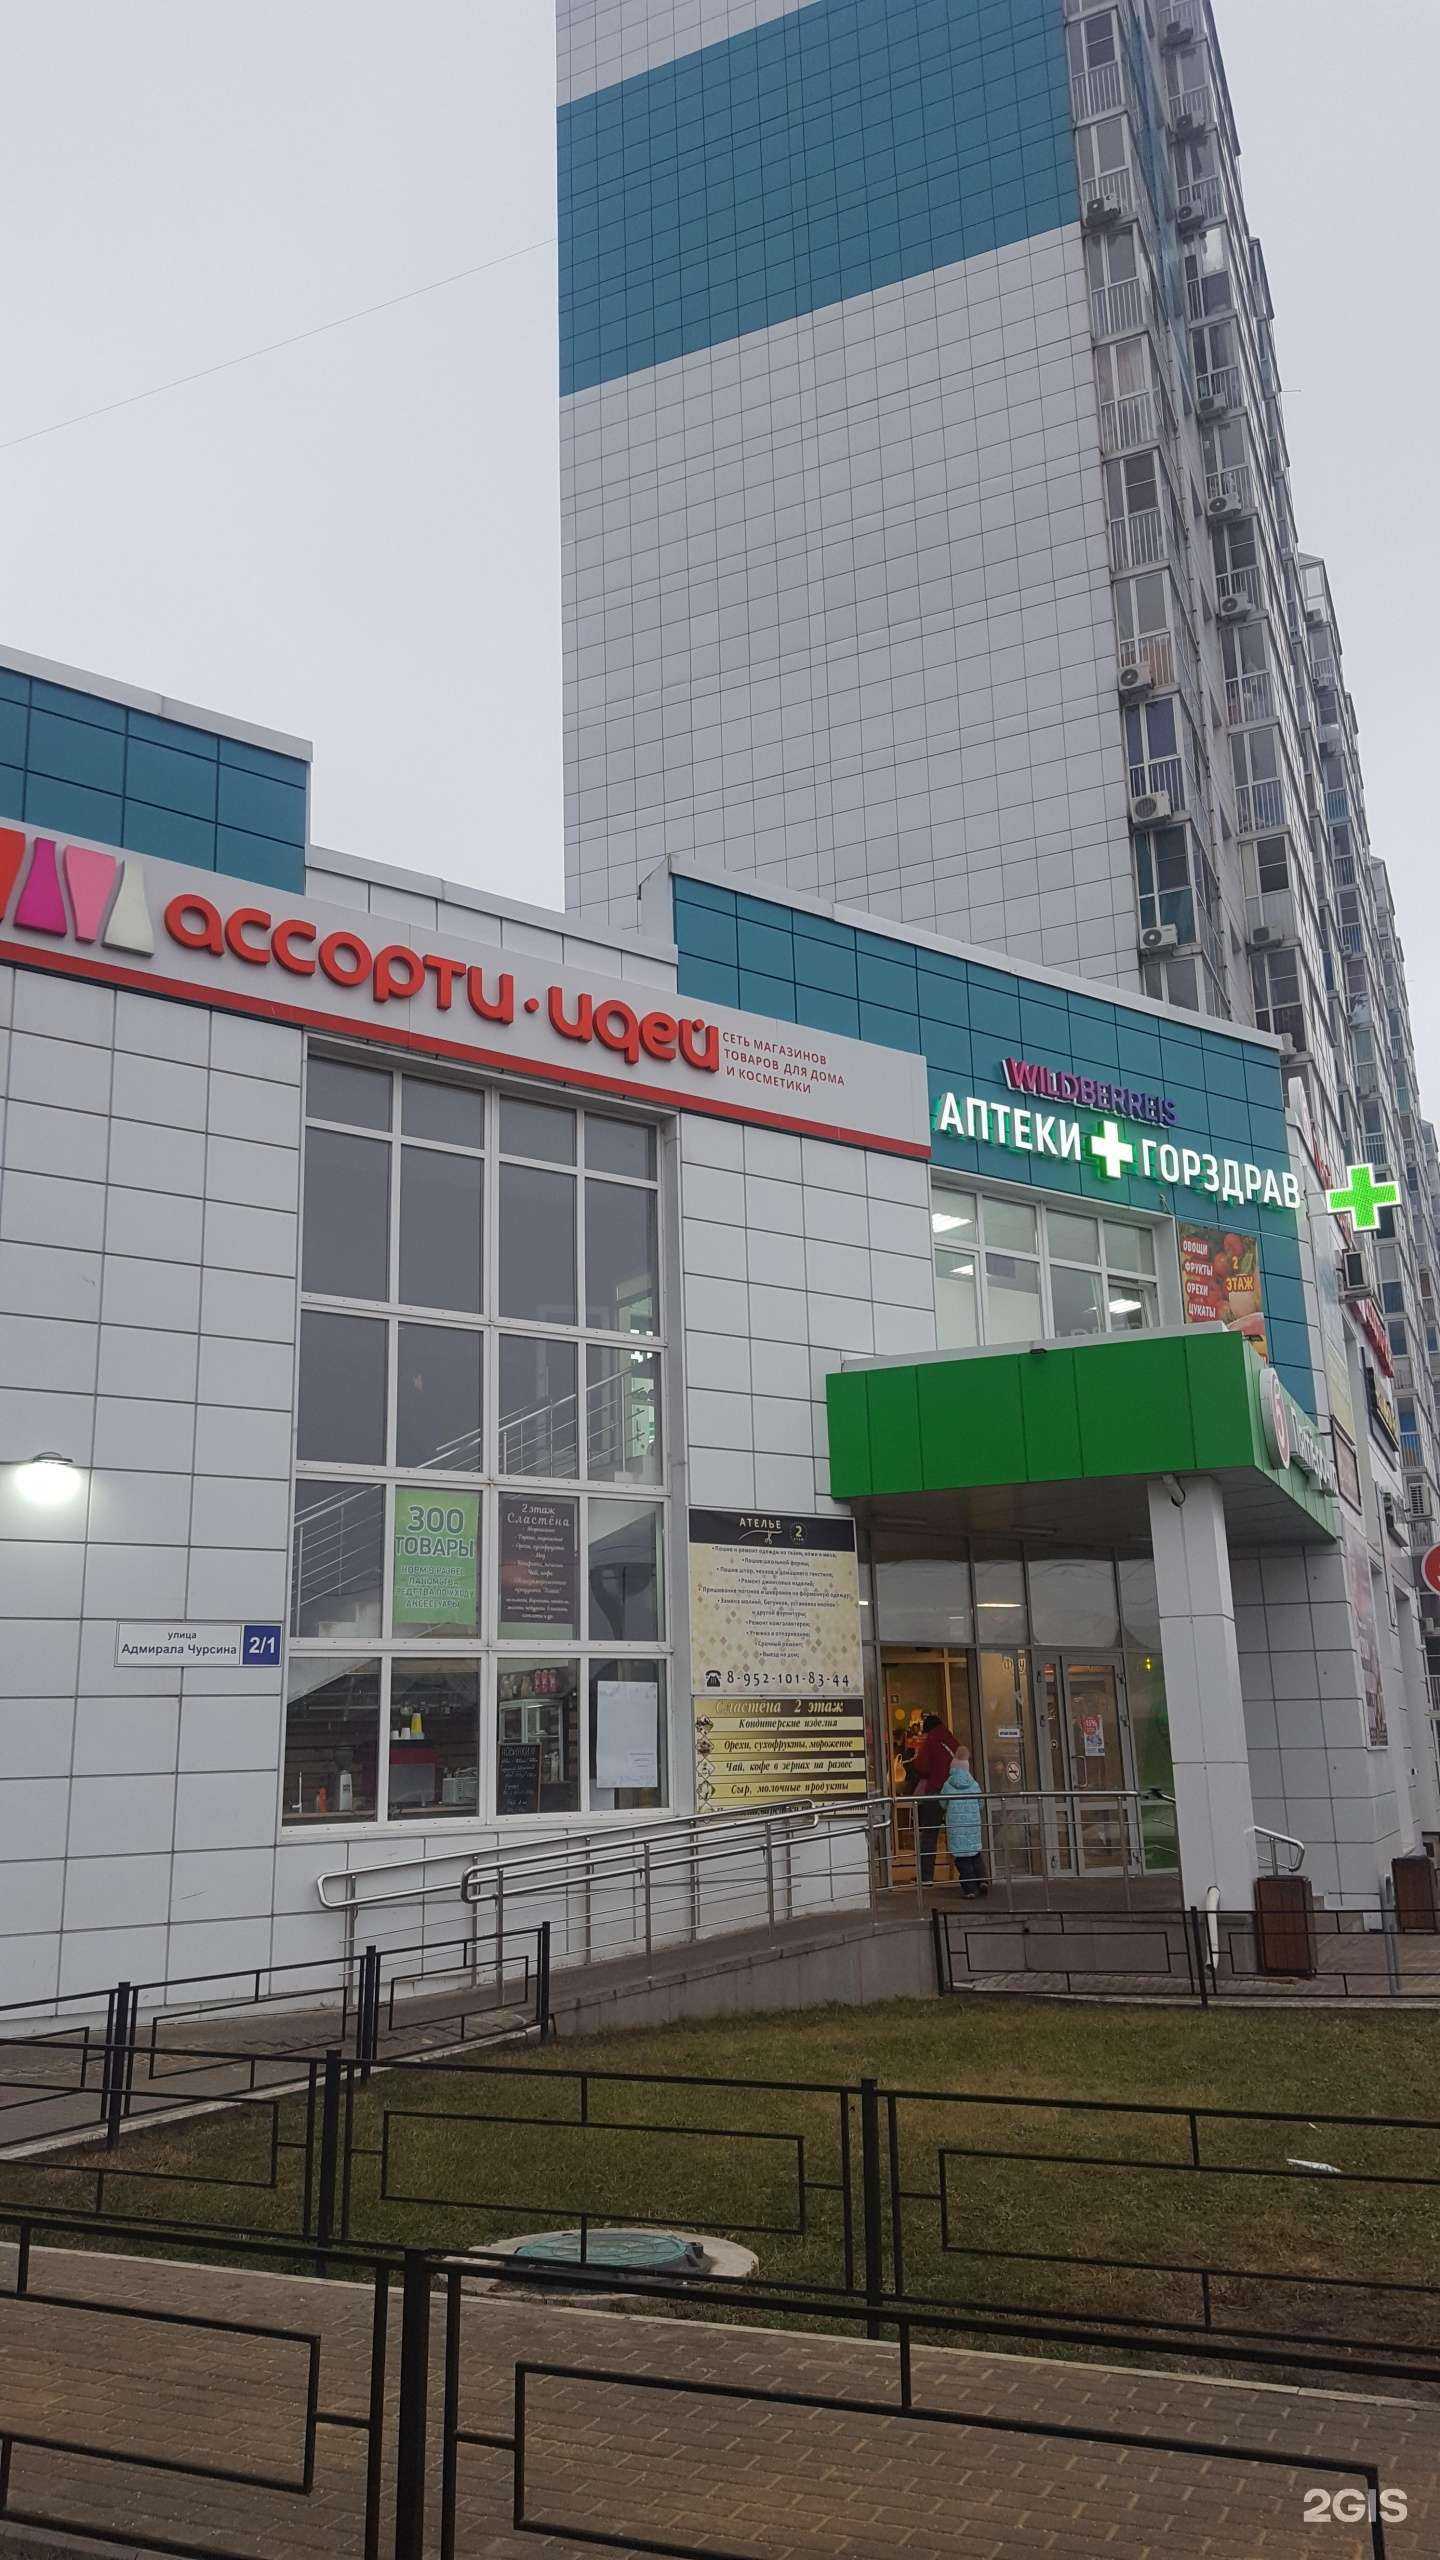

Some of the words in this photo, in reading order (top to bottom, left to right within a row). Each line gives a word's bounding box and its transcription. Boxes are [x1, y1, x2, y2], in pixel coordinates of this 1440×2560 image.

[164, 893, 514, 1025] ассорти
[548, 985, 720, 1074] идей
[722, 1031, 750, 1047] СЕТЬ
[753, 1039, 827, 1065] МАГАЗИНОВ
[723, 1049, 779, 1070] ТОВАРОВ
[784, 1062, 808, 1078] ДЛЯ
[810, 1069, 846, 1086] ДОМА
[726, 1066, 736, 1077] И
[738, 1069, 811, 1094] КОСМЕТИКИ
[938, 1091, 1082, 1161] АПТЕКИ
[1140, 1138, 1301, 1209] ГОРЗДРАВ
[1183, 1240, 1208, 1255] ОВОЩИ
[1185, 1261, 1213, 1276] ФРУКТЫ
[1232, 1256, 1238, 1269] 2
[1186, 1282, 1209, 1296] ОРЕХИ
[1226, 1276, 1254, 1291] ЭТАЖ
[1188, 1303, 1216, 1318] ЦУКАТЫ
[521, 1503, 528, 1513] 2
[529, 1506, 556, 1514] этаж
[507, 1512, 570, 1527] Сластёна
[739, 1517, 782, 1529] АТЕЛЬЕ
[795, 1525, 802, 1537] 2
[395, 1535, 475, 1559] ТОВАРЫ
[167, 1631, 197, 1641] улица
[121, 1644, 184, 1655] Адмирала
[188, 1644, 237, 1656] Чурсина
[249, 1637, 275, 1654] 2/1
[794, 1699, 801, 1713] 2
[808, 1702, 844, 1713] этаж
[738, 1719, 800, 1730] Кондитерские
[804, 1718, 838, 1728] изделия
[724, 1740, 751, 1752] Орехи,
[754, 1741, 808, 1752] сухофрукты,
[809, 1739, 853, 1751] мороженое
[726, 1762, 745, 1772] Чай,
[749, 1761, 770, 1774] кофе
[813, 1761, 824, 1769] на
[827, 1760, 853, 1772] развес
[731, 1784, 752, 1796] Сыр,
[756, 1783, 800, 1793] молочные
[805, 1781, 849, 1794] продукты
